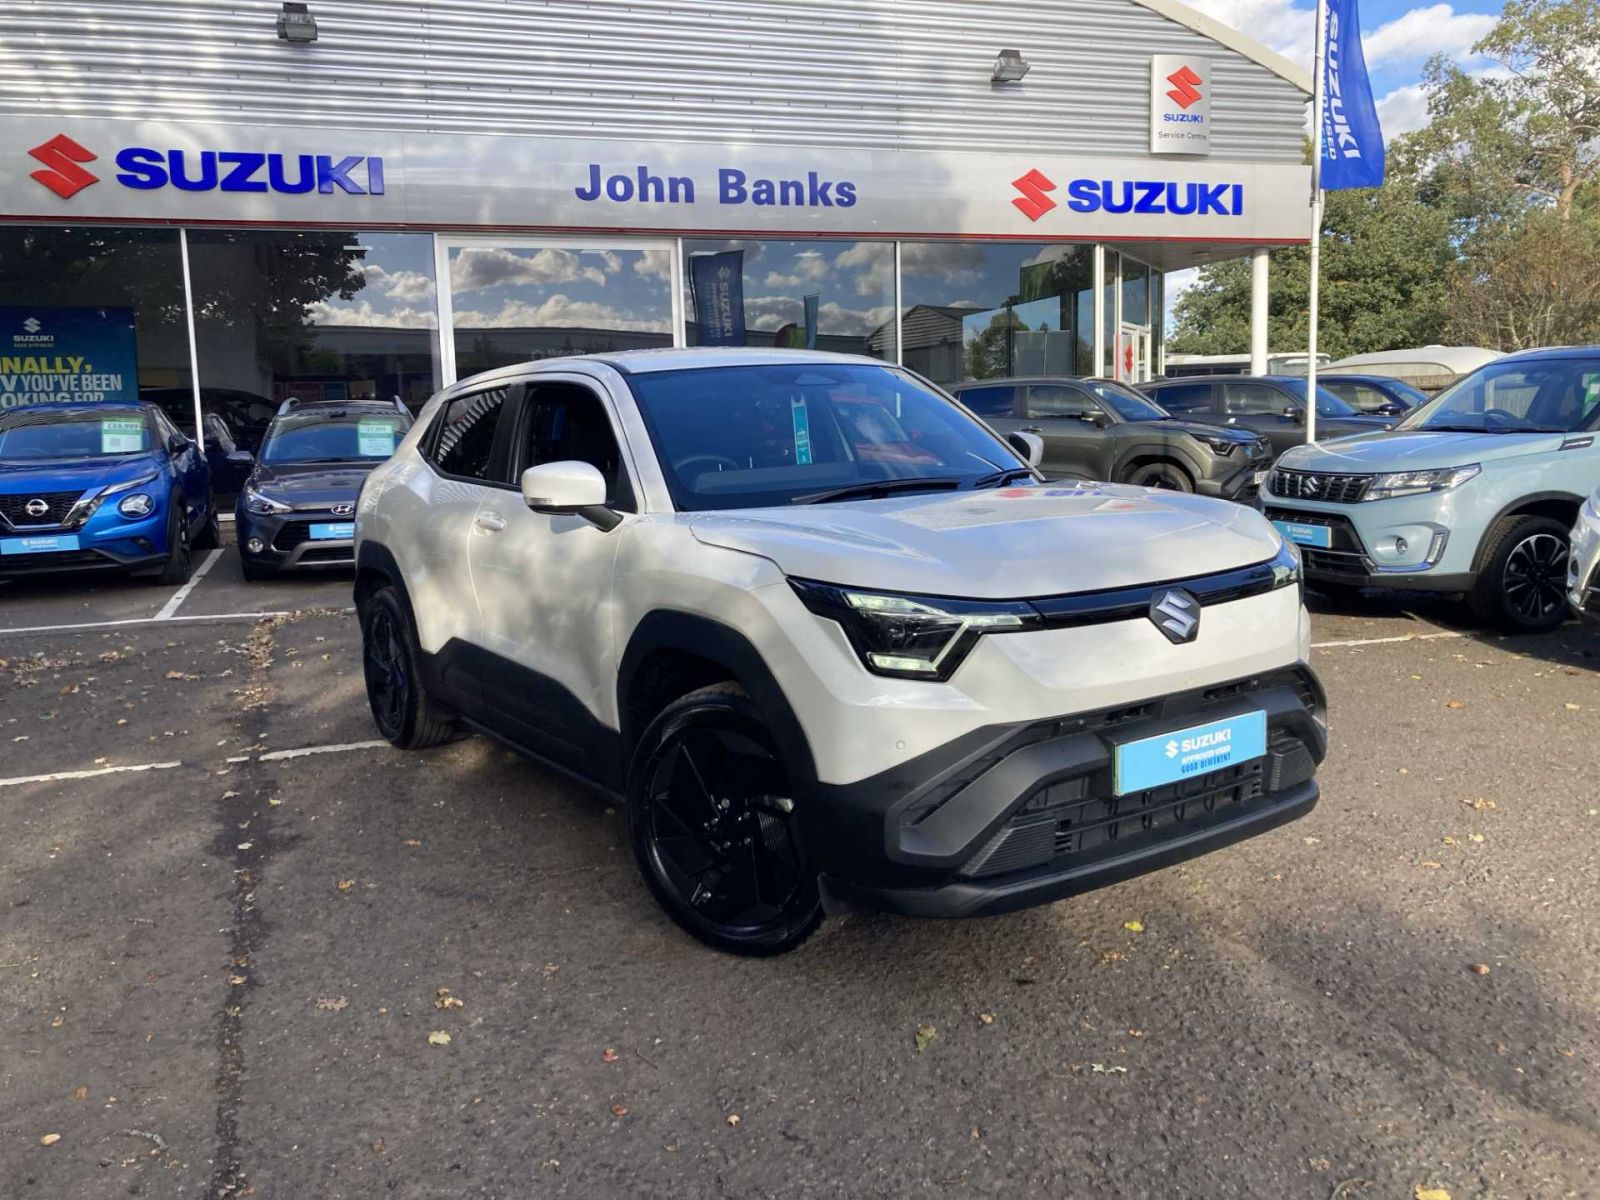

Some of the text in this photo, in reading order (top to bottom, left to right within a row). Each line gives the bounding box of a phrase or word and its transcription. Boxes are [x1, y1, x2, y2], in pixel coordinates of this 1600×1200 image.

[1328, 10, 1361, 159] SUZUKI
[1158, 131, 1207, 140] Service Centre
[1163, 113, 1204, 123] SUZUKI
[1323, 114, 1337, 160] USED
[115, 147, 385, 195] SUZUKI
[575, 164, 857, 207] John Banks
[1067, 179, 1243, 216] SUZUKI
[719, 282, 733, 337] SUZUKI
[21, 374, 81, 392] YOU'VE
[82, 374, 122, 391] BEEN
[1181, 729, 1231, 752] SUZUKI
